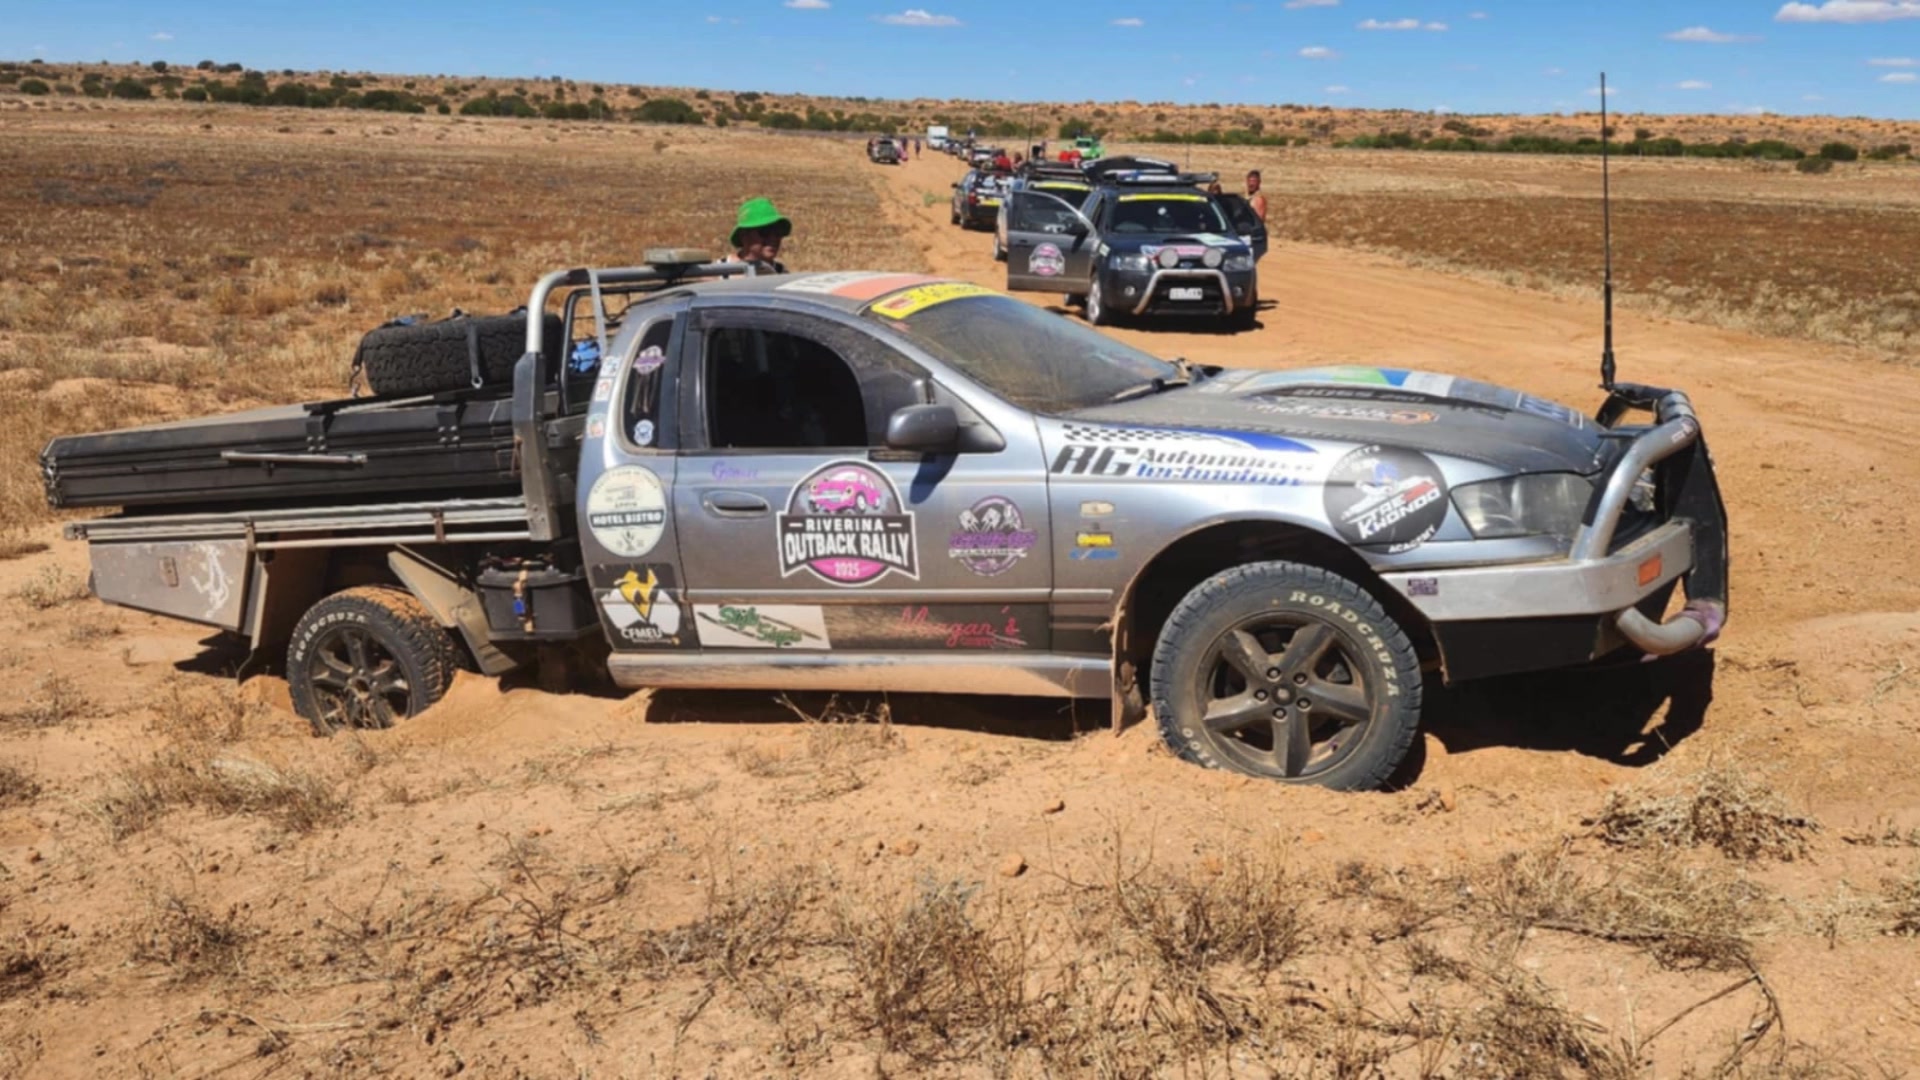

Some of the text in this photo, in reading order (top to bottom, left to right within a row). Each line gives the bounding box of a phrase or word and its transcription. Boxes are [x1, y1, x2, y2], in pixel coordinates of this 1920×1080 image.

[593, 511, 662, 526] HOTEL BISTRO
[805, 518, 884, 532] RIVERINA
[784, 532, 858, 565] OUTBACK
[860, 532, 910, 567] RALLY
[834, 561, 860, 577] 2025
[295, 611, 367, 662] ROADCRUZA
[620, 627, 663, 640] CFMEU
[1289, 590, 1401, 698] ROADCRUZA
